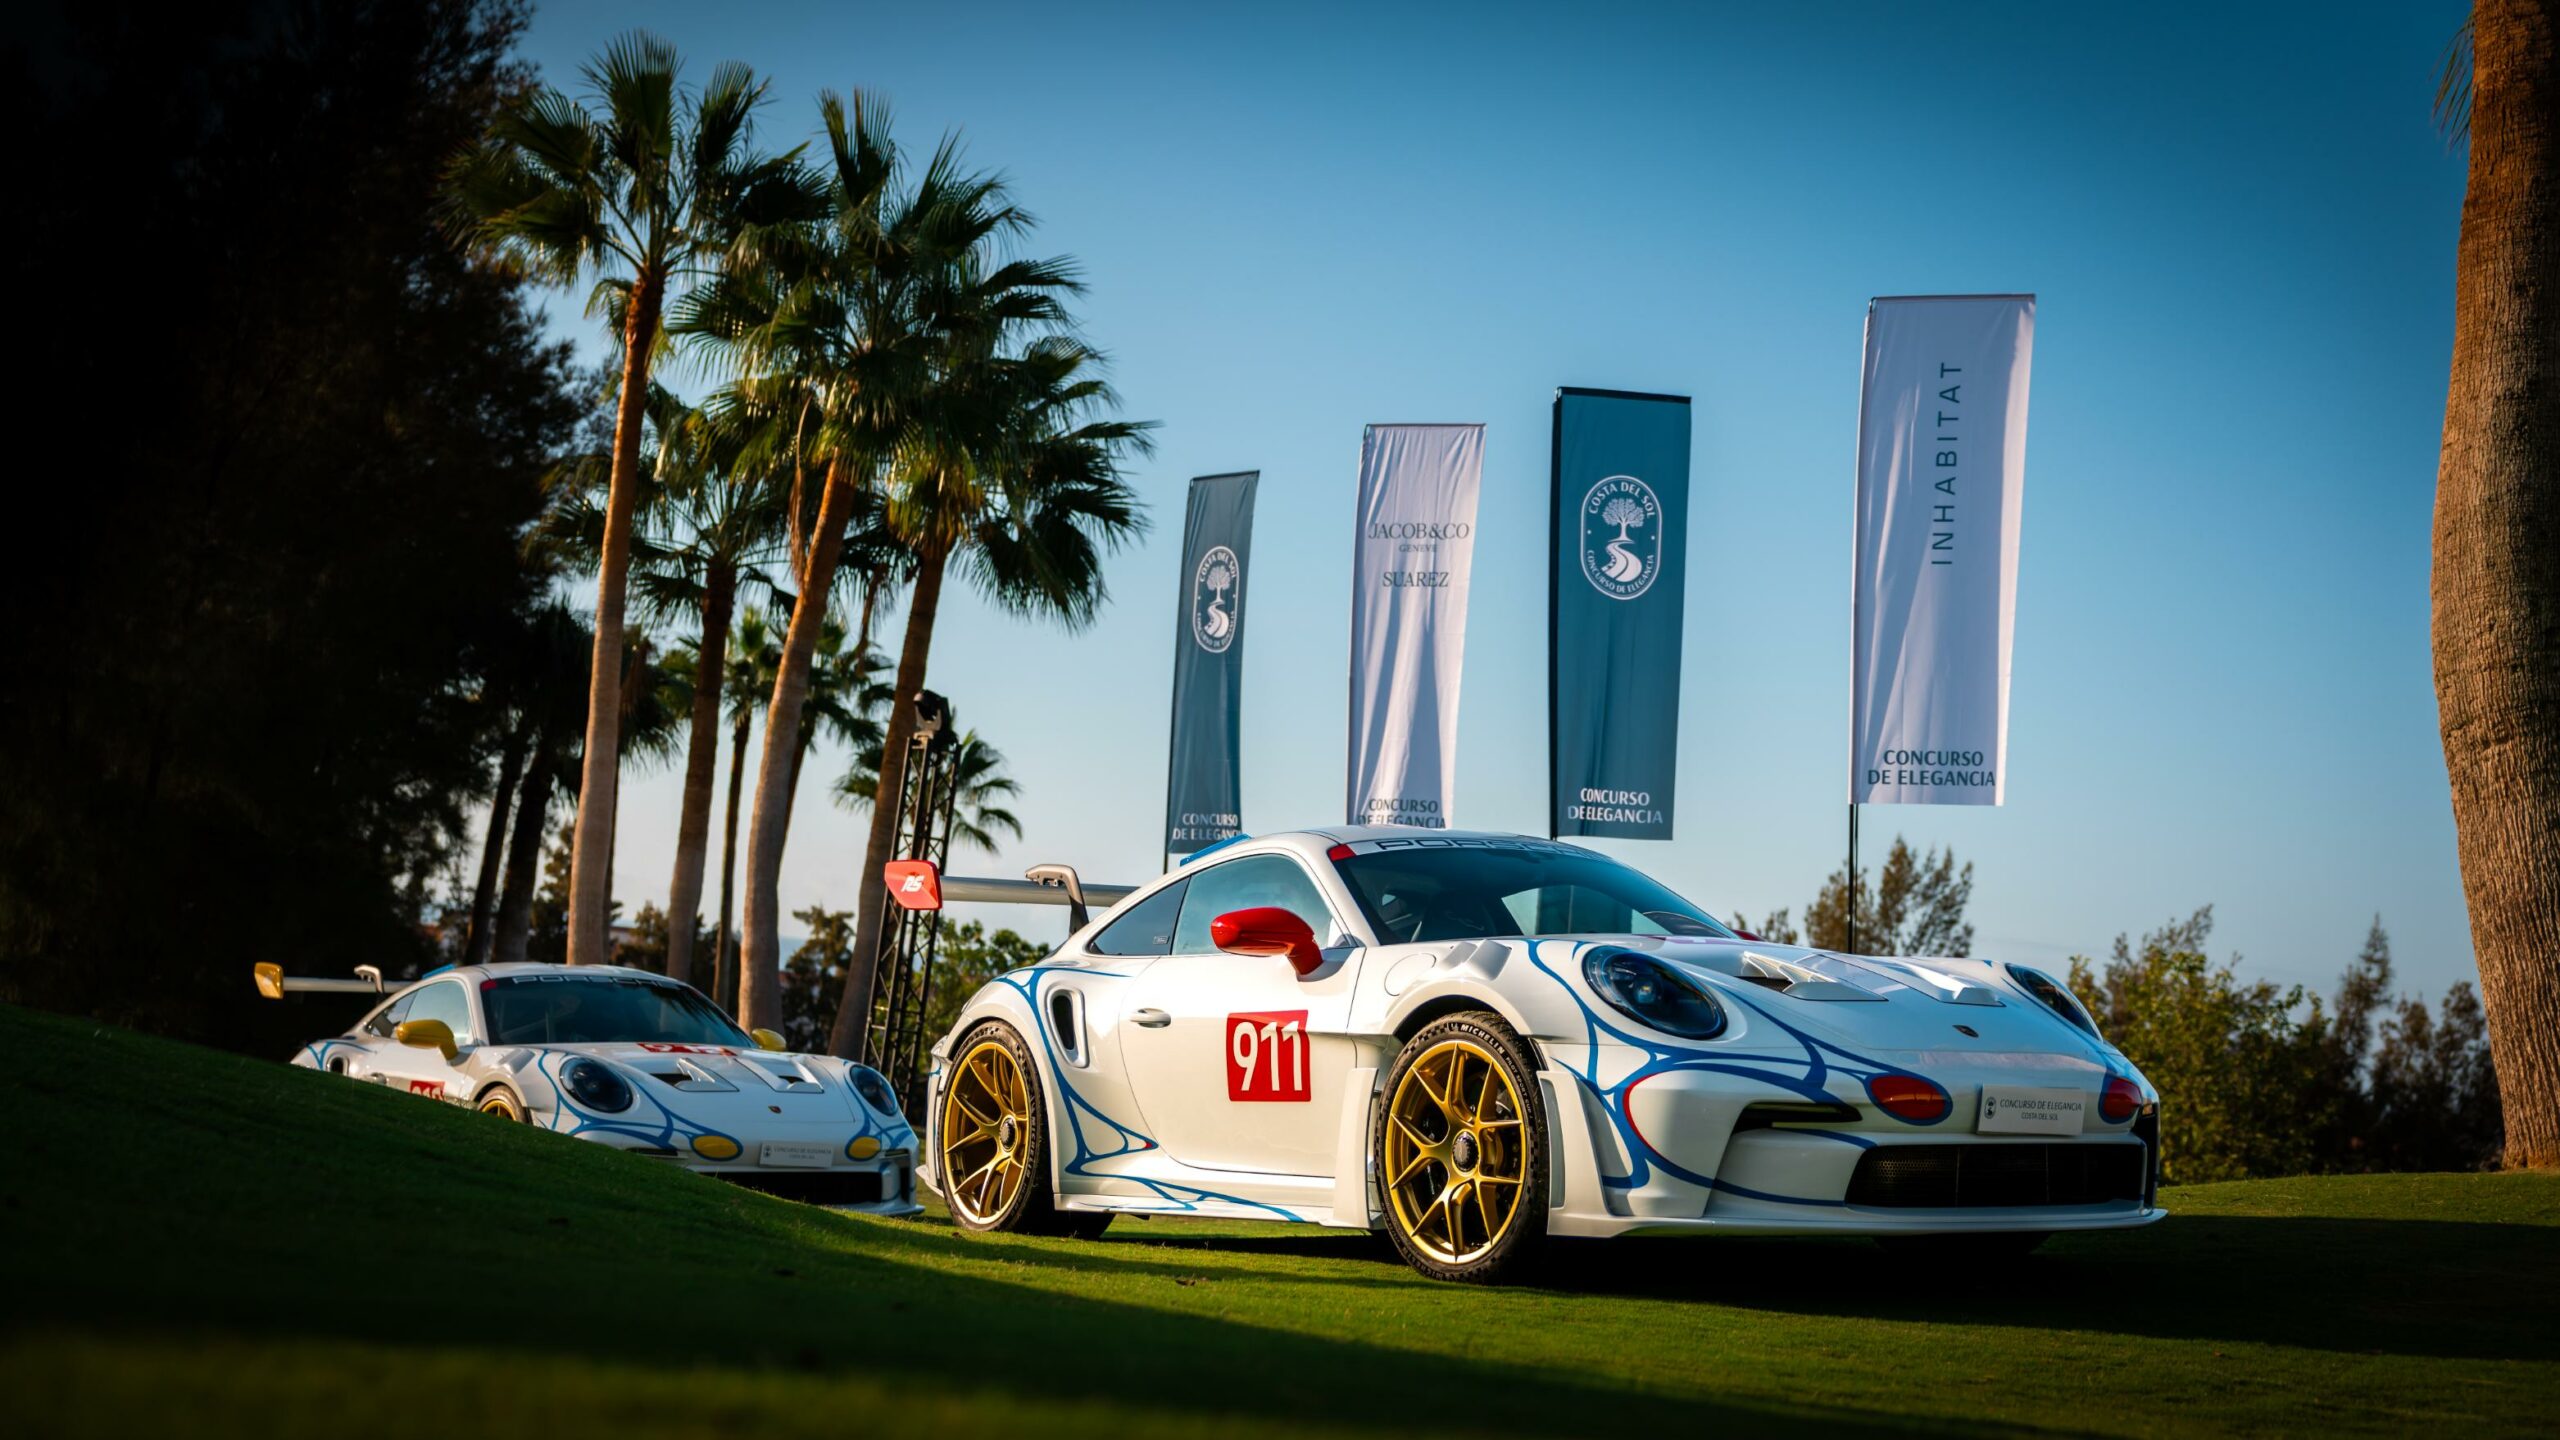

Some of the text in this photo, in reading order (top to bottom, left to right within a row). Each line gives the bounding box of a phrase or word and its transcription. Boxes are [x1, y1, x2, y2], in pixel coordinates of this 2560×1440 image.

[1931, 362, 1962, 564] INHABITAT
[1588, 481, 1656, 518] COSTA DEL SOL
[1368, 523, 1470, 540] JACOB&CO
[1382, 571, 1449, 587] SUAREZ
[1587, 549, 1655, 593] CONCURSO DE ELEGANCIA
[1883, 750, 1984, 766] CONCURSO
[1868, 769, 1996, 786] DE ELEGANCIA
[1369, 798, 1438, 813] CONCURSO
[1580, 788, 1650, 806] CONCURSO
[1182, 813, 1238, 826] CONCURSO
[1356, 815, 1373, 825] DE
[1567, 805, 1663, 824] DE ELEGANCIA
[1173, 827, 1188, 840] DE
[1460, 1023, 1506, 1055] MICHELIN
[1233, 1020, 1303, 1091] 911
[2000, 1099, 2082, 1111] CONCURSO DE ELEGANCIA
[2021, 1112, 2037, 1120] COSTA
